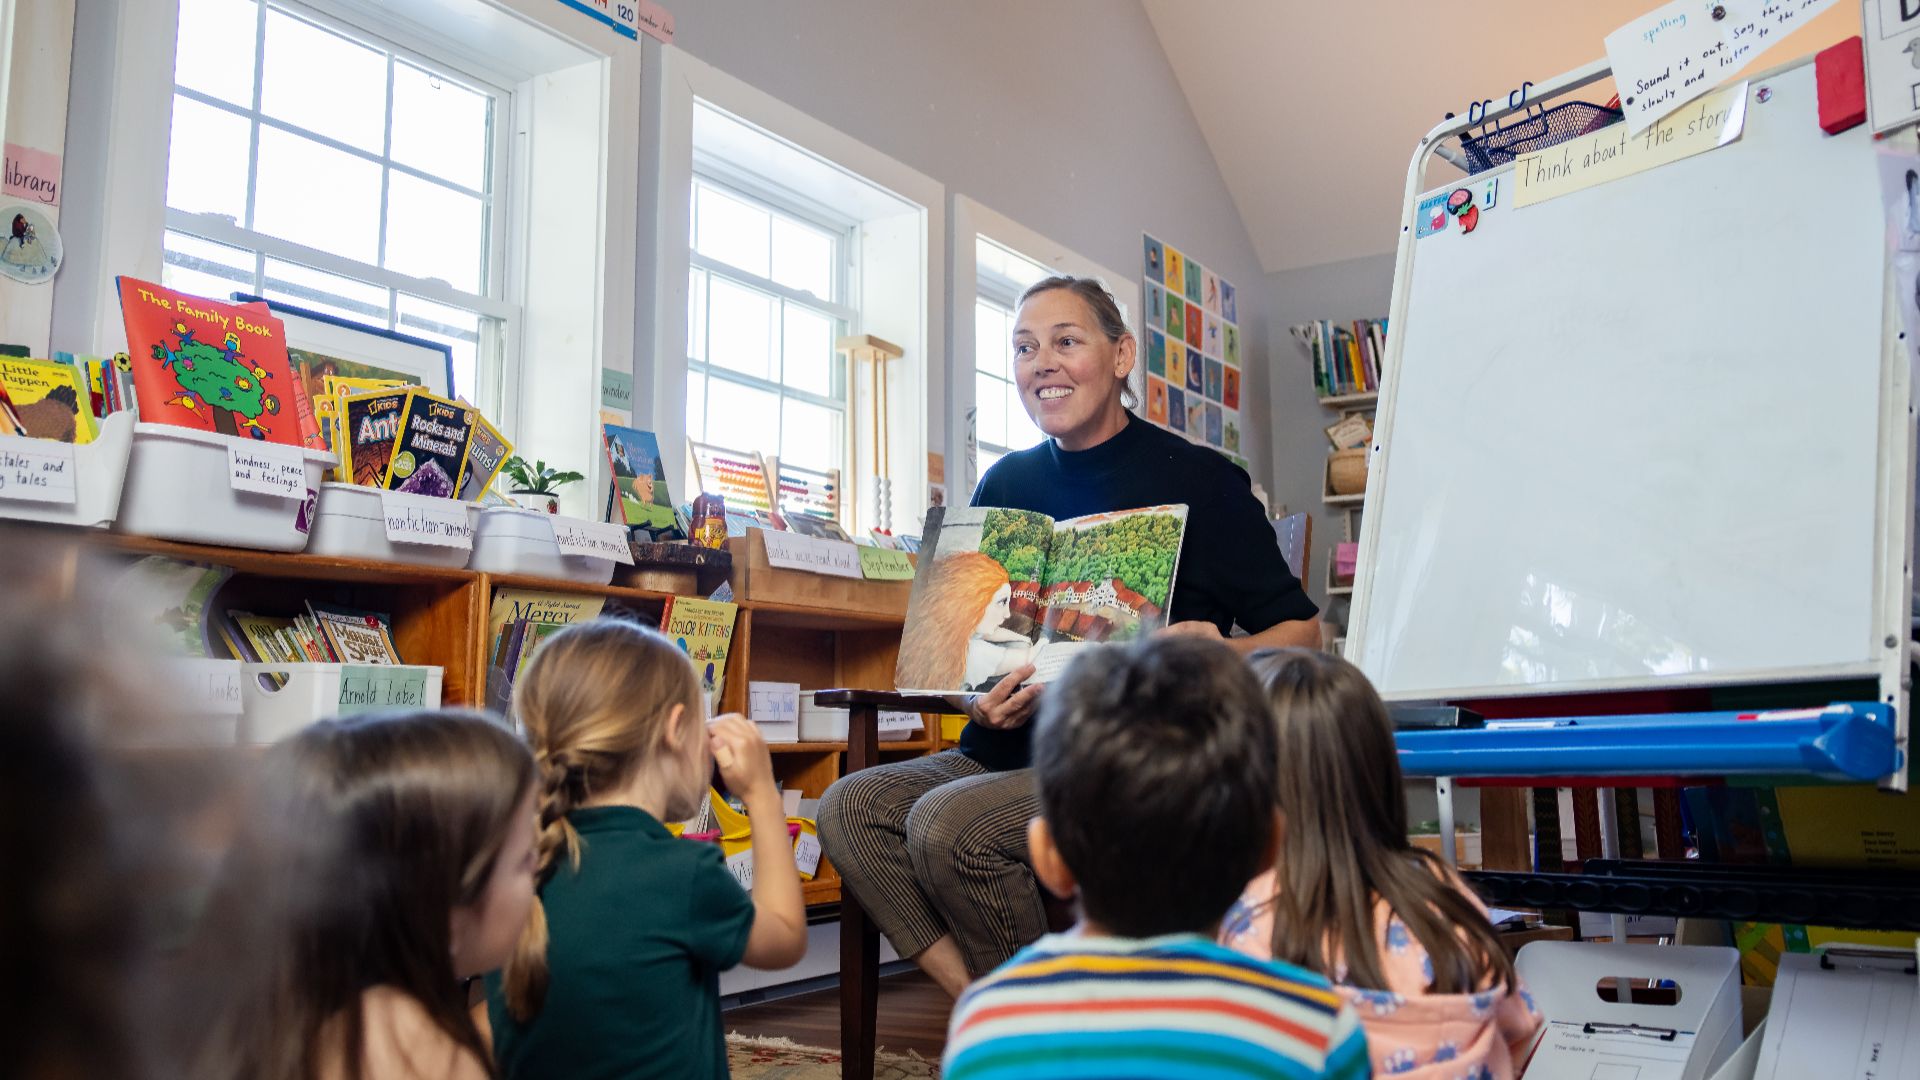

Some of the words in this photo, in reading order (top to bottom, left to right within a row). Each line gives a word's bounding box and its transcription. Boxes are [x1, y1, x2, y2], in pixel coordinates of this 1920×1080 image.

[617, 3, 634, 22] 120
[1643, 14, 1686, 43] spelling
[1636, 67, 1670, 94] Sound
[1679, 57, 1690, 71] it
[1734, 22, 1755, 39] Say
[1642, 89, 1675, 111] slowly
[1684, 69, 1705, 87] and
[1720, 44, 1750, 67] listen
[1759, 28, 1769, 38] to
[1517, 148, 1573, 187] Think
[1583, 132, 1626, 168] about
[1646, 119, 1673, 150] the
[4, 157, 57, 202] library
[137, 287, 171, 310] The
[176, 299, 229, 330] Family
[235, 316, 272, 337] Book
[0, 372, 50, 387] Tuppen
[2, 363, 39, 376] Little
[377, 401, 398, 412] KIDS
[436, 408, 455, 419] KIDS
[358, 411, 401, 444] Ant
[411, 414, 444, 435] Rocks
[444, 426, 467, 443] and
[411, 432, 457, 458] Minerals
[0, 452, 30, 469] tales
[43, 461, 64, 473] and
[235, 450, 275, 473] kindness,
[281, 465, 302, 477] peace
[17, 473, 47, 487] tales
[235, 470, 251, 480] and
[262, 471, 298, 492] feelings
[864, 553, 909, 577] September
[506, 601, 577, 623] Mercy
[671, 620, 697, 637] COLOR
[698, 621, 731, 638] KITTENS
[339, 677, 377, 705] Arnold
